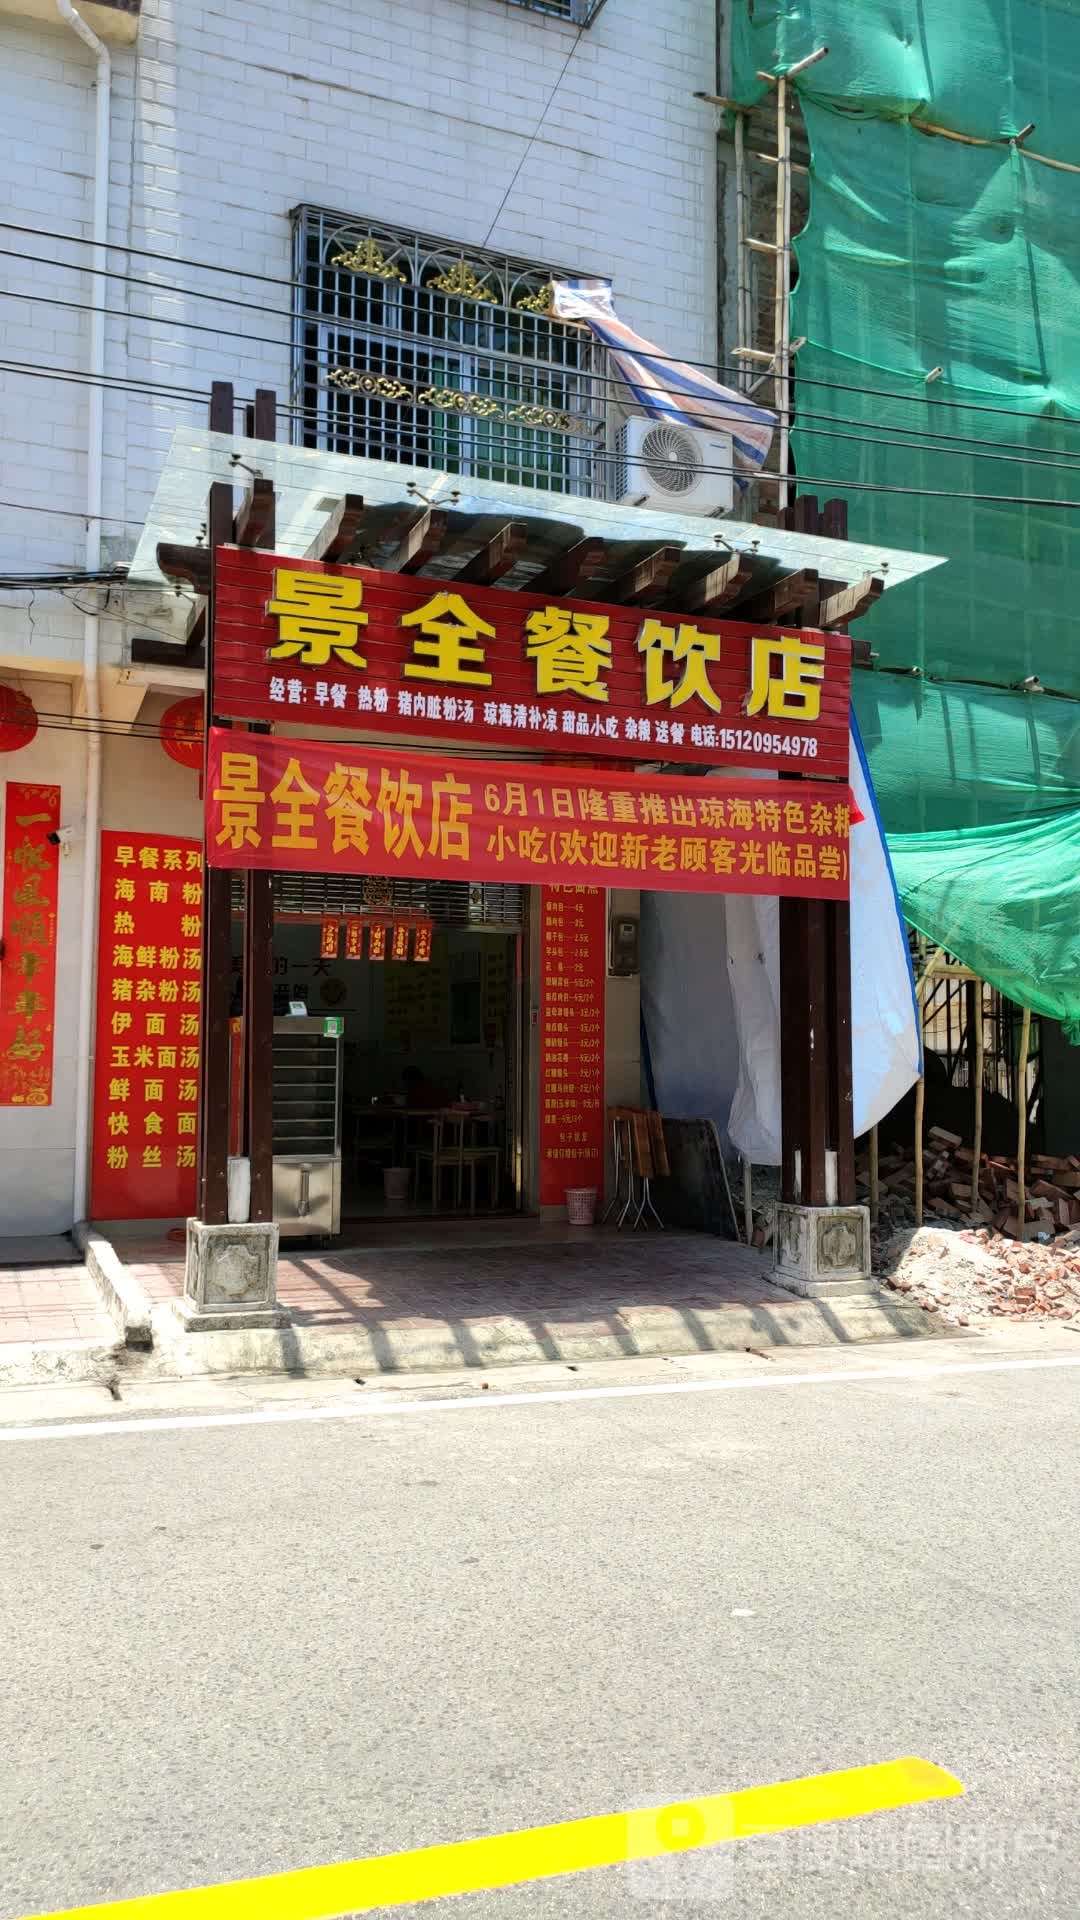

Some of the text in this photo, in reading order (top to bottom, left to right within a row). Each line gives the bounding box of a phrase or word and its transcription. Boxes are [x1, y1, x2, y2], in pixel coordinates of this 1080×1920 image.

[266, 568, 826, 722] 景全餐饮店
[269, 676, 307, 705] 经营:
[313, 680, 347, 709] 早餐
[357, 684, 389, 714] 热粉
[397, 688, 475, 724] 猪内脏粉汤
[483, 700, 558, 735] 琼海清补凉
[561, 709, 619, 740] 甜品小吃
[624, 716, 651, 743] 杂粮
[655, 718, 685, 745] 送餐
[213, 751, 473, 862] 景全餐饮店
[114, 845, 203, 873] 早餐系列
[486, 823, 848, 882] 小吃(欢迎新老顾客光临品尝)
[114, 878, 202, 905] 海南粉
[113, 944, 202, 972] 海鲜粉汤
[112, 978, 201, 1004] 猪杂粉汤
[110, 1044, 200, 1070] 玉米面汤
